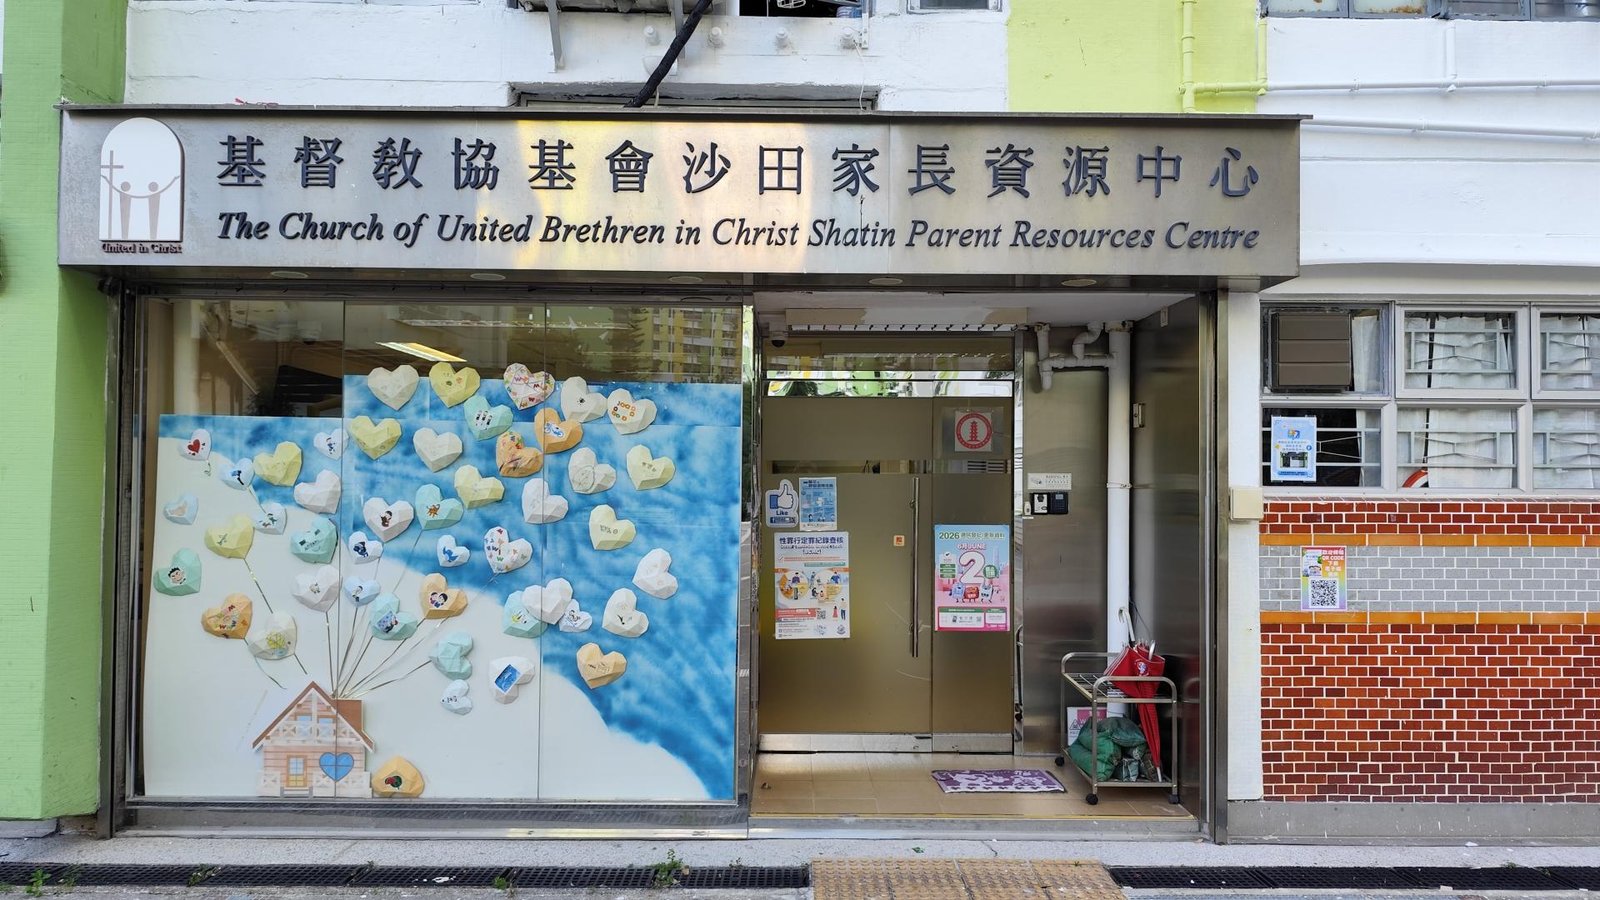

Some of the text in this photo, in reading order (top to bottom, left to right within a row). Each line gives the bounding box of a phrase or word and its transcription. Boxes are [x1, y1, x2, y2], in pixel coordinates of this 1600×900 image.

[218, 212, 1259, 249] The Church of United Brethren in Christ Shatin Parent Resources Centre
[939, 532, 960, 540] 2026
[959, 551, 985, 584] 2
